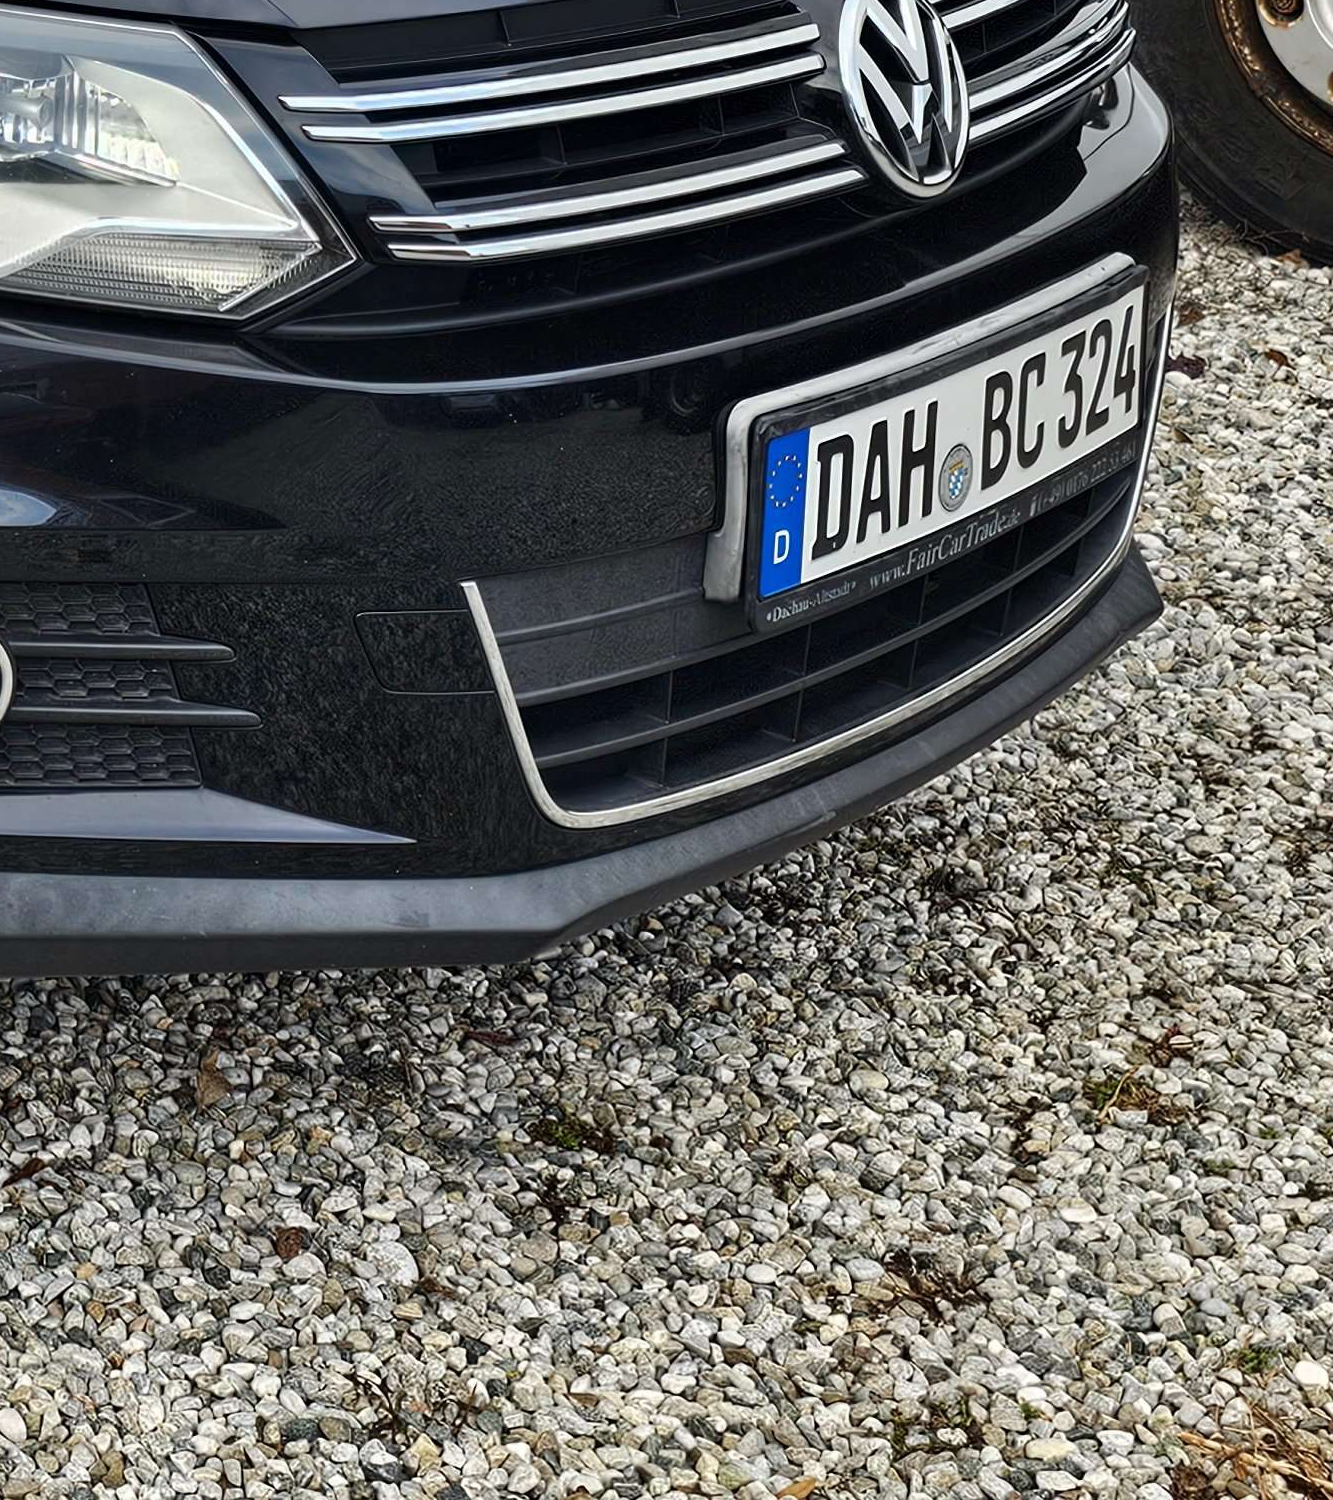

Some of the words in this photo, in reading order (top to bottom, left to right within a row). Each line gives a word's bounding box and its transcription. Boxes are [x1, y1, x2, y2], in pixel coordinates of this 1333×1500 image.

[811, 400, 939, 561] DAH
[981, 351, 1047, 492] BC
[1057, 304, 1136, 450] 324
[772, 529, 791, 565] D
